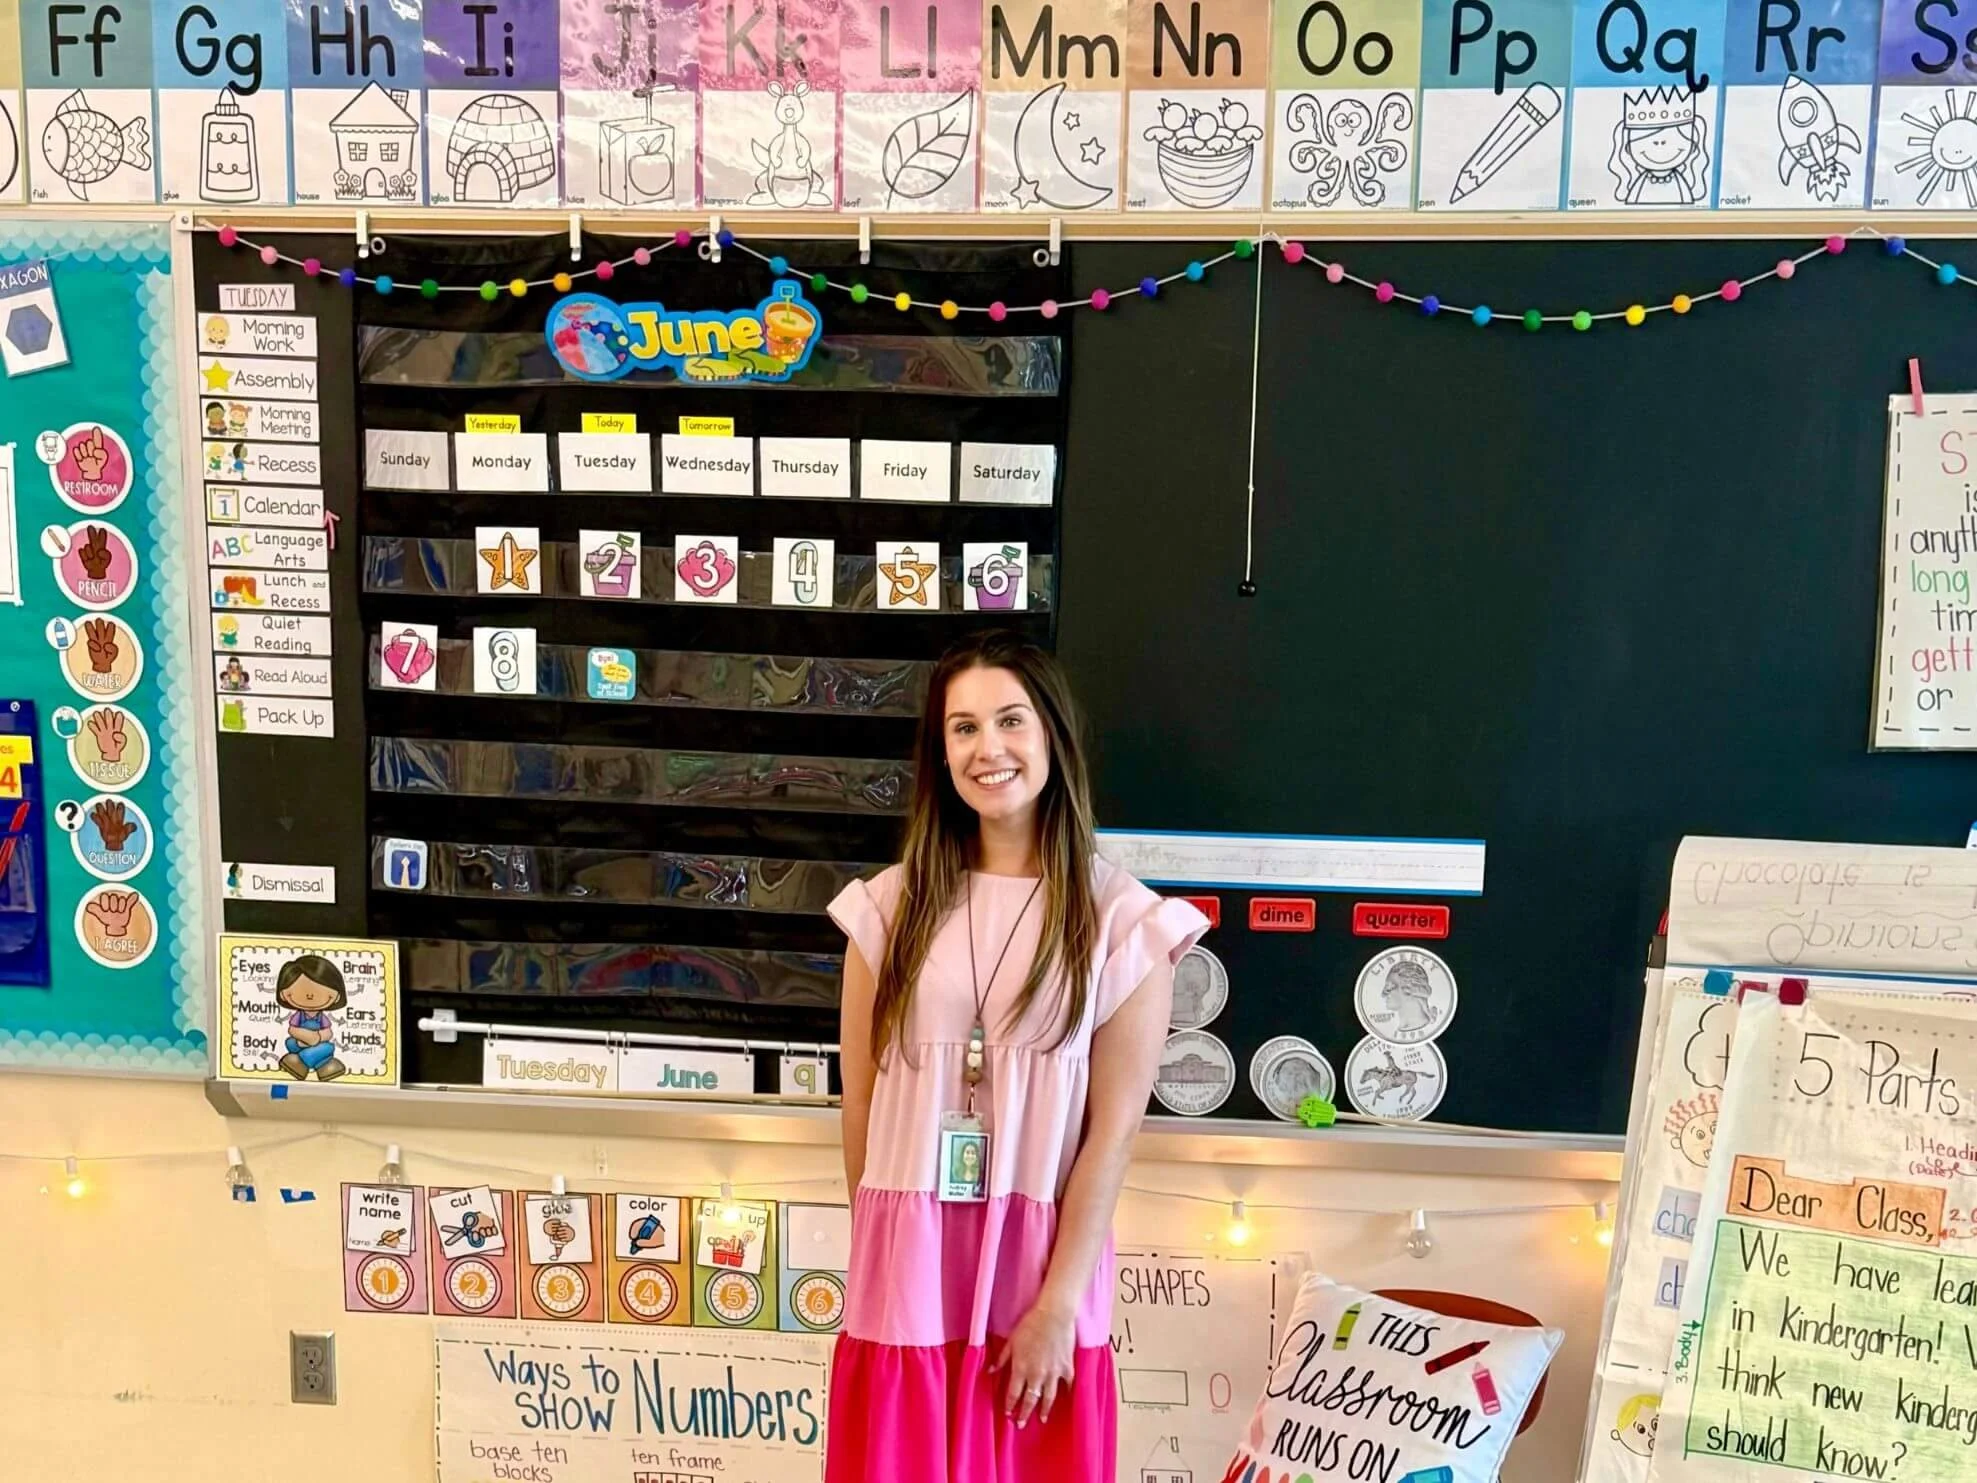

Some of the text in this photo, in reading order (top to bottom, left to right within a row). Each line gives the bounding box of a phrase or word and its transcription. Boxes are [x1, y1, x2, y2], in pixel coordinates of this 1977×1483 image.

[49, 5, 121, 76] Ff
[312, 5, 396, 76] Hh
[464, 5, 514, 76] Ii
[727, 5, 807, 76] Kk
[881, 5, 937, 78] Ll
[991, 4, 1118, 79] Mm
[1152, 2, 1240, 78] Nn
[1297, 1, 1393, 75] Oo
[1596, 0, 1708, 93] Qq
[1756, 0, 1845, 73] Rr
[175, 6, 262, 95] Gg
[1450, 0, 1537, 94] Pp
[33, 190, 48, 199] fish
[164, 192, 179, 201] glue
[431, 193, 450, 202] igloo
[843, 198, 860, 208] leaf
[985, 200, 1008, 208] moon
[1127, 199, 1146, 208] nest
[1272, 199, 1307, 209] octopus
[1419, 199, 1435, 209] pen
[1568, 198, 1596, 207] queen
[1720, 196, 1751, 206] rocket
[225, 287, 287, 307] TUESDAY
[243, 319, 304, 339] Morning
[628, 311, 764, 359] June
[253, 336, 295, 352] Work
[234, 370, 314, 393] Assembly
[260, 406, 311, 423] Morning
[595, 416, 624, 431] Today
[684, 418, 731, 430] Tomorrow
[261, 421, 311, 438] Meeting
[469, 418, 517, 432] Yesterday
[380, 451, 430, 469] Sunday
[472, 455, 531, 470] Monday
[574, 455, 636, 471] Tuesday
[1940, 431, 1977, 475] S
[258, 455, 317, 473] Recess
[666, 456, 750, 474] Wednesday
[772, 460, 839, 476] Thursday
[884, 463, 927, 480] Friday
[974, 465, 1040, 483] Saturday
[64, 480, 118, 496] RESTROOM
[244, 496, 321, 517] Calendar
[212, 534, 254, 560] ABC
[255, 531, 323, 551] Language
[274, 553, 306, 568] Arts
[503, 537, 512, 580] 1
[598, 542, 623, 584] 2
[693, 548, 720, 588] 3
[789, 549, 817, 592] 4
[894, 553, 921, 595] 5
[982, 553, 1009, 596] 6
[264, 573, 326, 589] Lunch and
[1912, 560, 1970, 604] long
[271, 594, 320, 608] Recess
[262, 616, 302, 631] Quiet
[254, 636, 312, 654] Reading
[400, 635, 419, 675] 7
[492, 639, 518, 681] 8
[82, 673, 122, 689] WATER
[255, 669, 328, 684] Read Aloud
[1918, 688, 1953, 711] or
[258, 707, 324, 727] Pack Up
[89, 851, 136, 866] QUESTION
[252, 874, 324, 893] Dismissal
[1260, 907, 1304, 924] dime
[1366, 913, 1435, 930] quarter
[104, 938, 137, 953] AGREE
[239, 960, 270, 975] Eyes
[343, 961, 376, 975] Brain
[238, 1000, 281, 1014] Mouth
[346, 1008, 375, 1021] Ears
[243, 1035, 277, 1051] Body
[341, 1032, 381, 1045] Hands
[497, 1055, 607, 1088] Tuesday
[657, 1064, 717, 1089] June
[1794, 1033, 1839, 1096] 5
[1860, 1041, 1959, 1116] Parts
[362, 1192, 400, 1206] write
[450, 1192, 473, 1209] cut
[629, 1198, 668, 1212] color
[1740, 1167, 1934, 1242] Dear Class,
[359, 1207, 401, 1220] name
[748, 1214, 766, 1227] up
[1740, 1228, 1790, 1277] We
[1833, 1242, 1900, 1294] have
[379, 1270, 388, 1292] 1
[463, 1276, 481, 1298] 2
[553, 1279, 568, 1301] 3
[1120, 1267, 1211, 1307] SHAPES
[639, 1287, 657, 1305] 4
[726, 1286, 742, 1307] 5
[812, 1292, 826, 1311] 6
[1732, 1300, 1754, 1332] in
[1368, 1313, 1441, 1357] THIS
[1674, 1331, 1698, 1371] Body
[484, 1347, 620, 1395] Ways to
[1717, 1347, 1786, 1399] think
[1812, 1382, 1863, 1412] new
[1266, 1320, 1491, 1450] Classroom
[515, 1358, 818, 1445] SHOW Numbers
[470, 1439, 568, 1464] base ten
[1271, 1418, 1400, 1483] RUNS ON
[1707, 1408, 1907, 1481] should know?
[632, 1448, 725, 1471] ten frame
[494, 1462, 553, 1483] blocks
